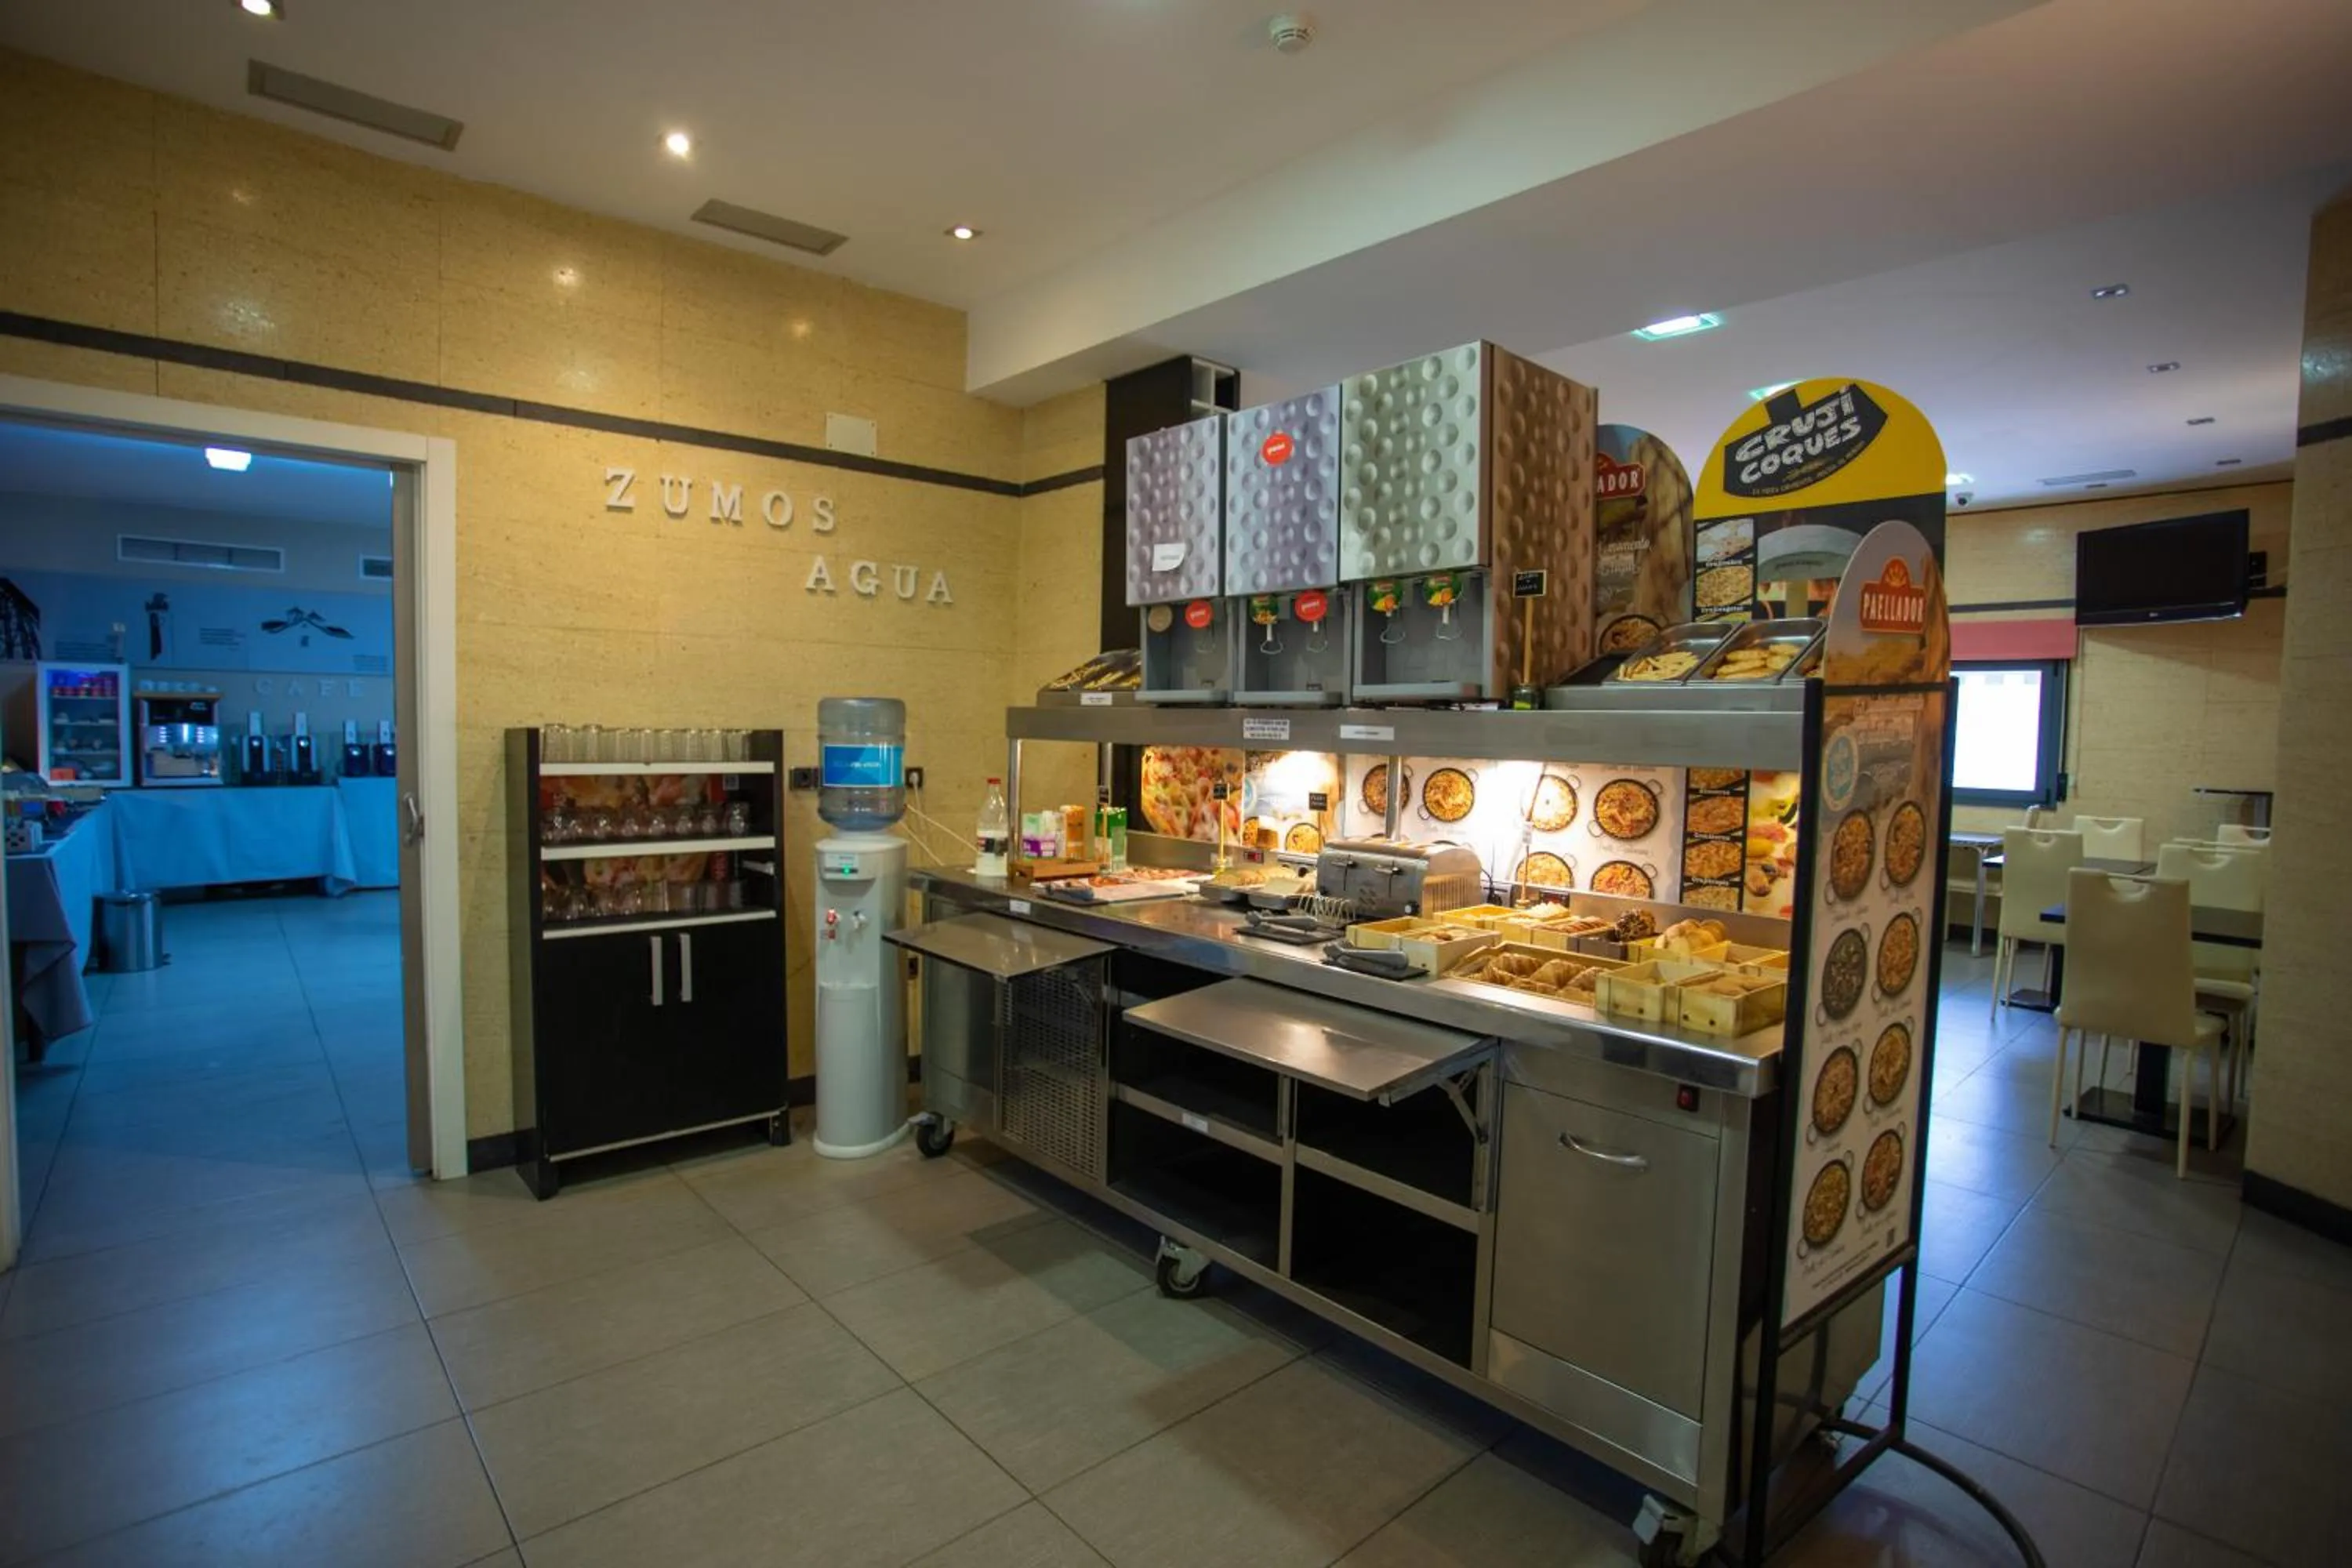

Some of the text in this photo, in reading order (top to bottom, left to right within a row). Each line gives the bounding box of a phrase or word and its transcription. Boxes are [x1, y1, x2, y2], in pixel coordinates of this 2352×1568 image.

[1740, 416, 1862, 484] COQUES
[605, 467, 835, 532] ZUMOS
[805, 555, 954, 603] AGUA
[1863, 593, 1924, 623] PAELLADOR
